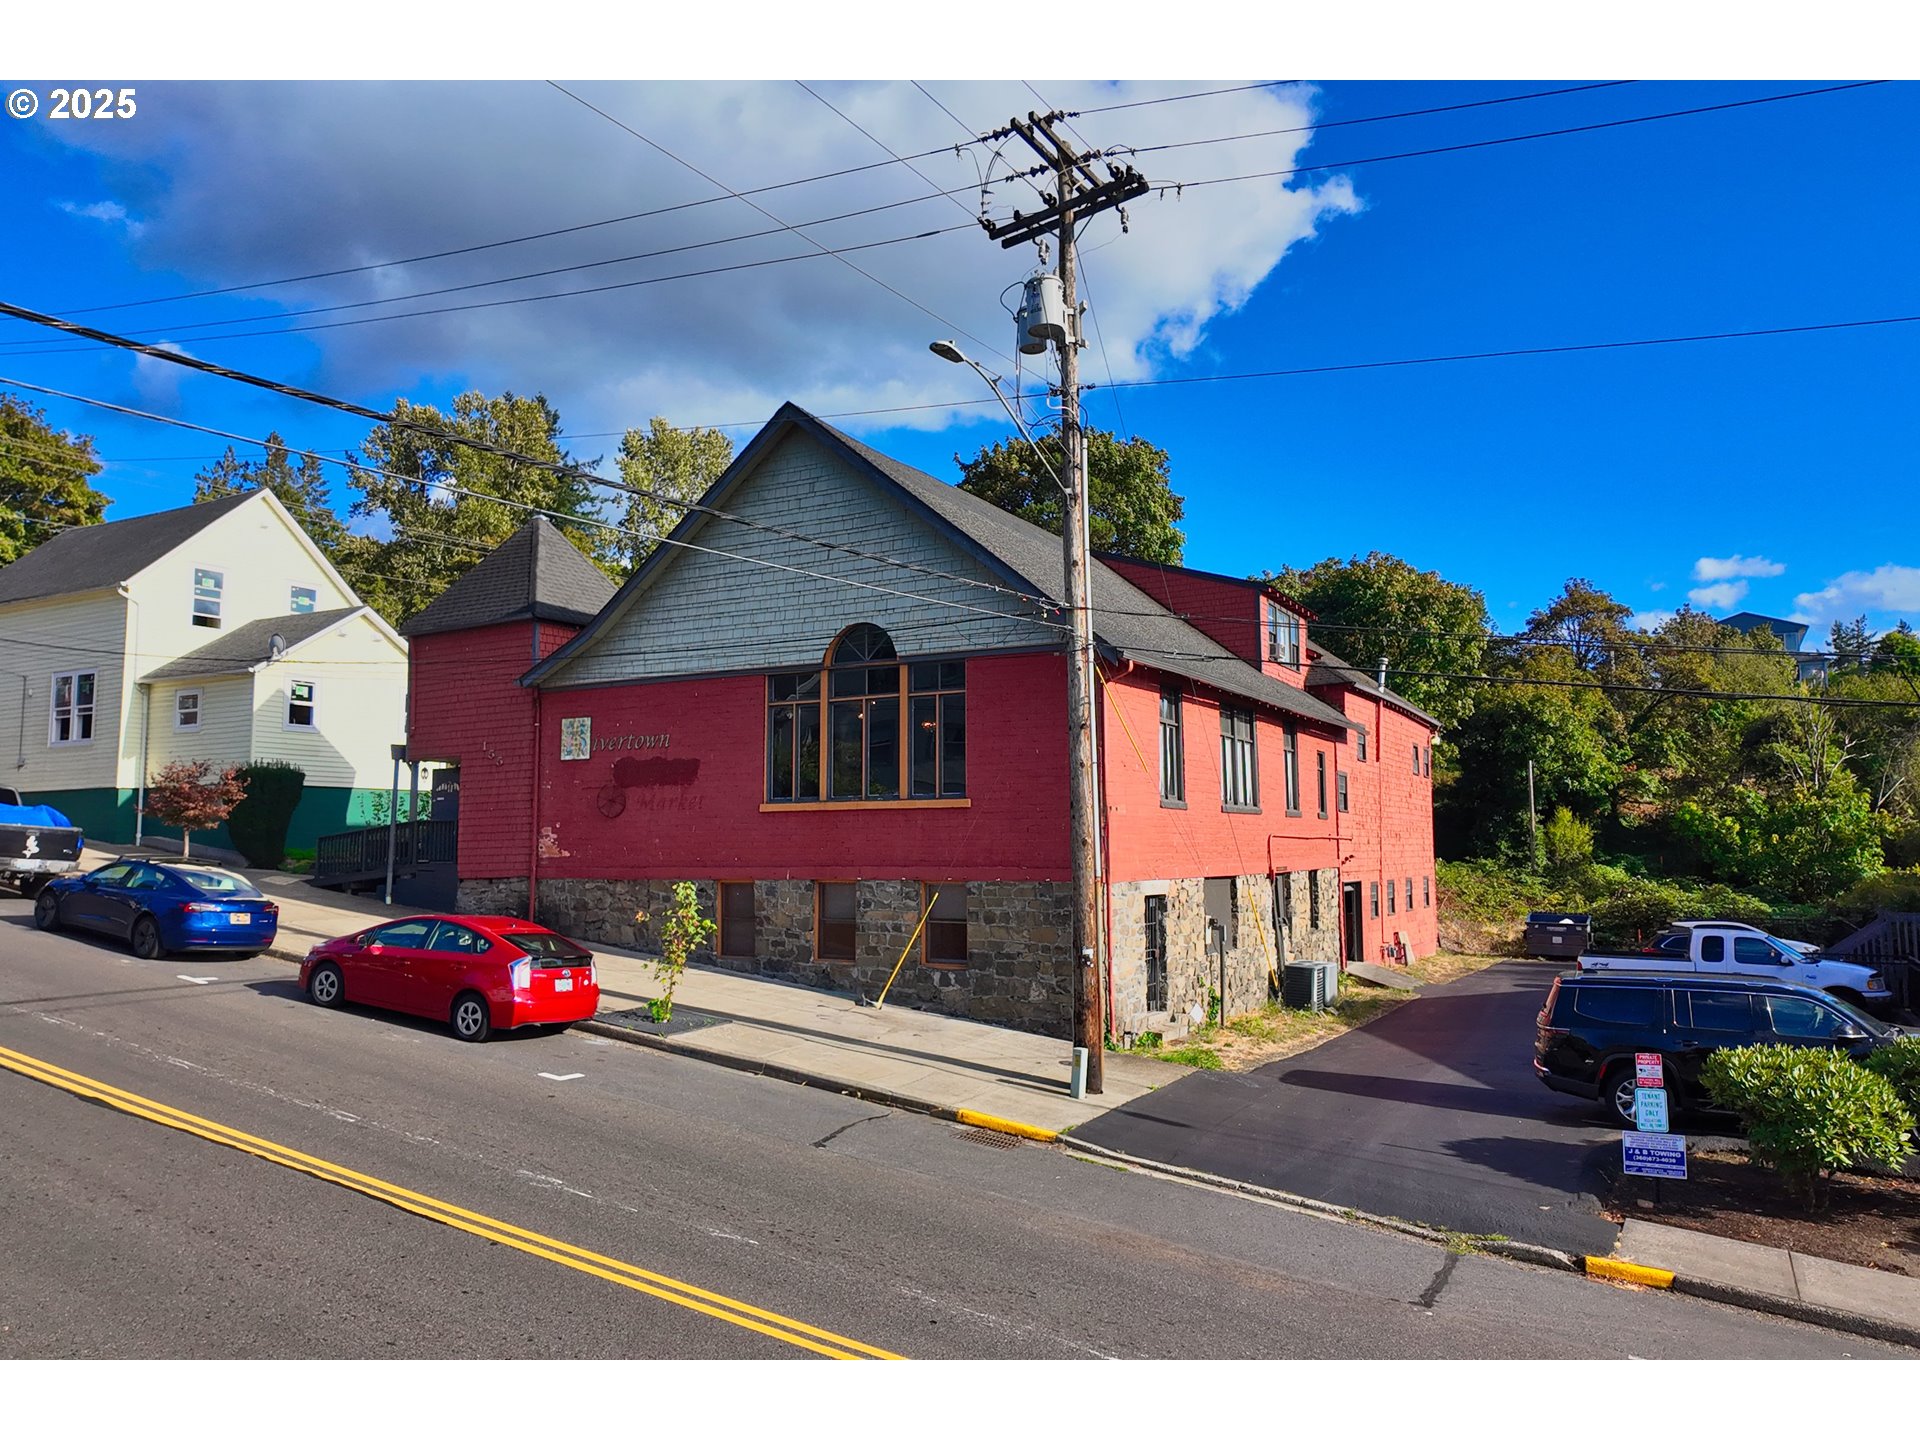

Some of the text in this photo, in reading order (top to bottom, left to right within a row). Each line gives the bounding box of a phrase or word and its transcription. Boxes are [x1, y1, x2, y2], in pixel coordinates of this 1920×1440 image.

[1641, 1092, 1660, 1100] TENANT
[1640, 1101, 1663, 1109] PARKING
[1645, 1109, 1659, 1117] ONLY
[1650, 1150, 1681, 1158] TOWING
